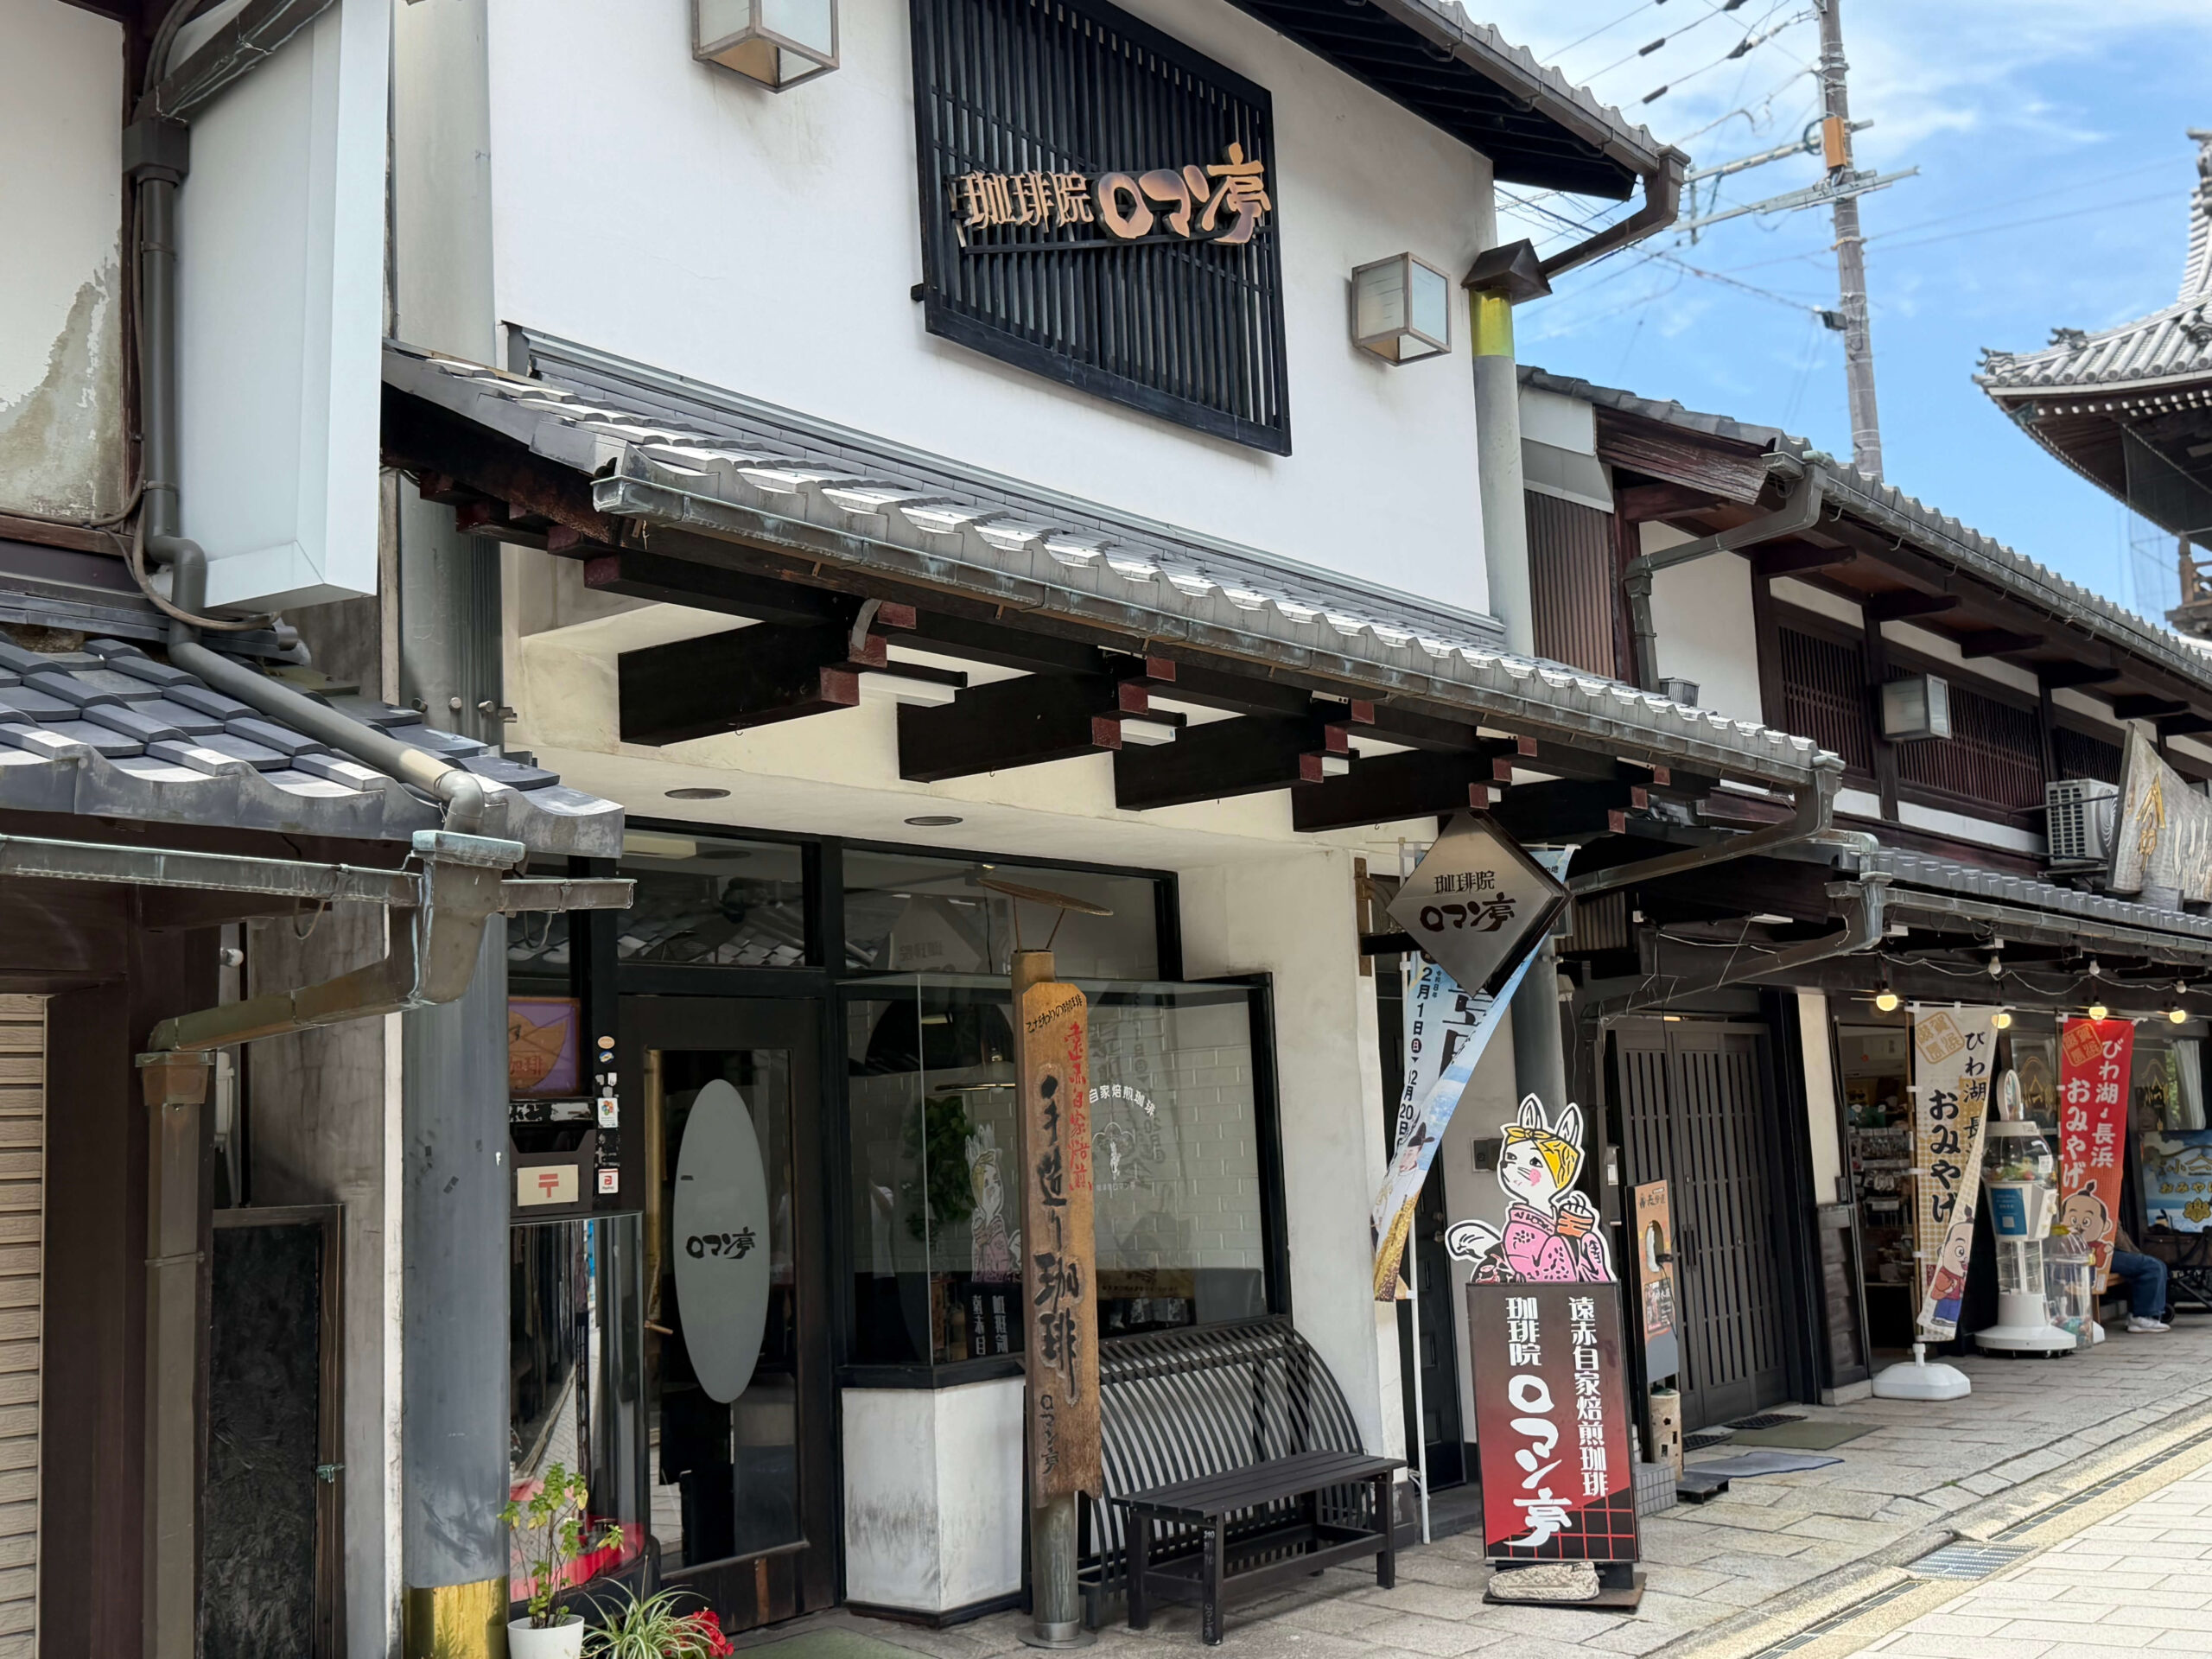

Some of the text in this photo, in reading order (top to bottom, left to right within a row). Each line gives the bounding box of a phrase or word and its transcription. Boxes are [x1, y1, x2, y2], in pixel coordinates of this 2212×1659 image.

[960, 142, 1271, 245] 珈琲院 ロマン亭
[1420, 892, 1516, 932] ロマン亭
[1433, 870, 1495, 894] 珈琲院
[1026, 994, 1083, 1033] こだわりの珈琲
[1089, 1084, 1156, 1117] 自家焙煎珈琲
[1963, 1032, 1986, 1103] びわ湖
[1929, 1090, 1961, 1223] おみやげ
[2063, 1077, 2091, 1189] おみやげ
[686, 1226, 756, 1260] ロマン亭
[1503, 1297, 1572, 1547] 珈琲院 ロマン亭
[1568, 1296, 1608, 1497] 遠赤自家焙煎珈琲
